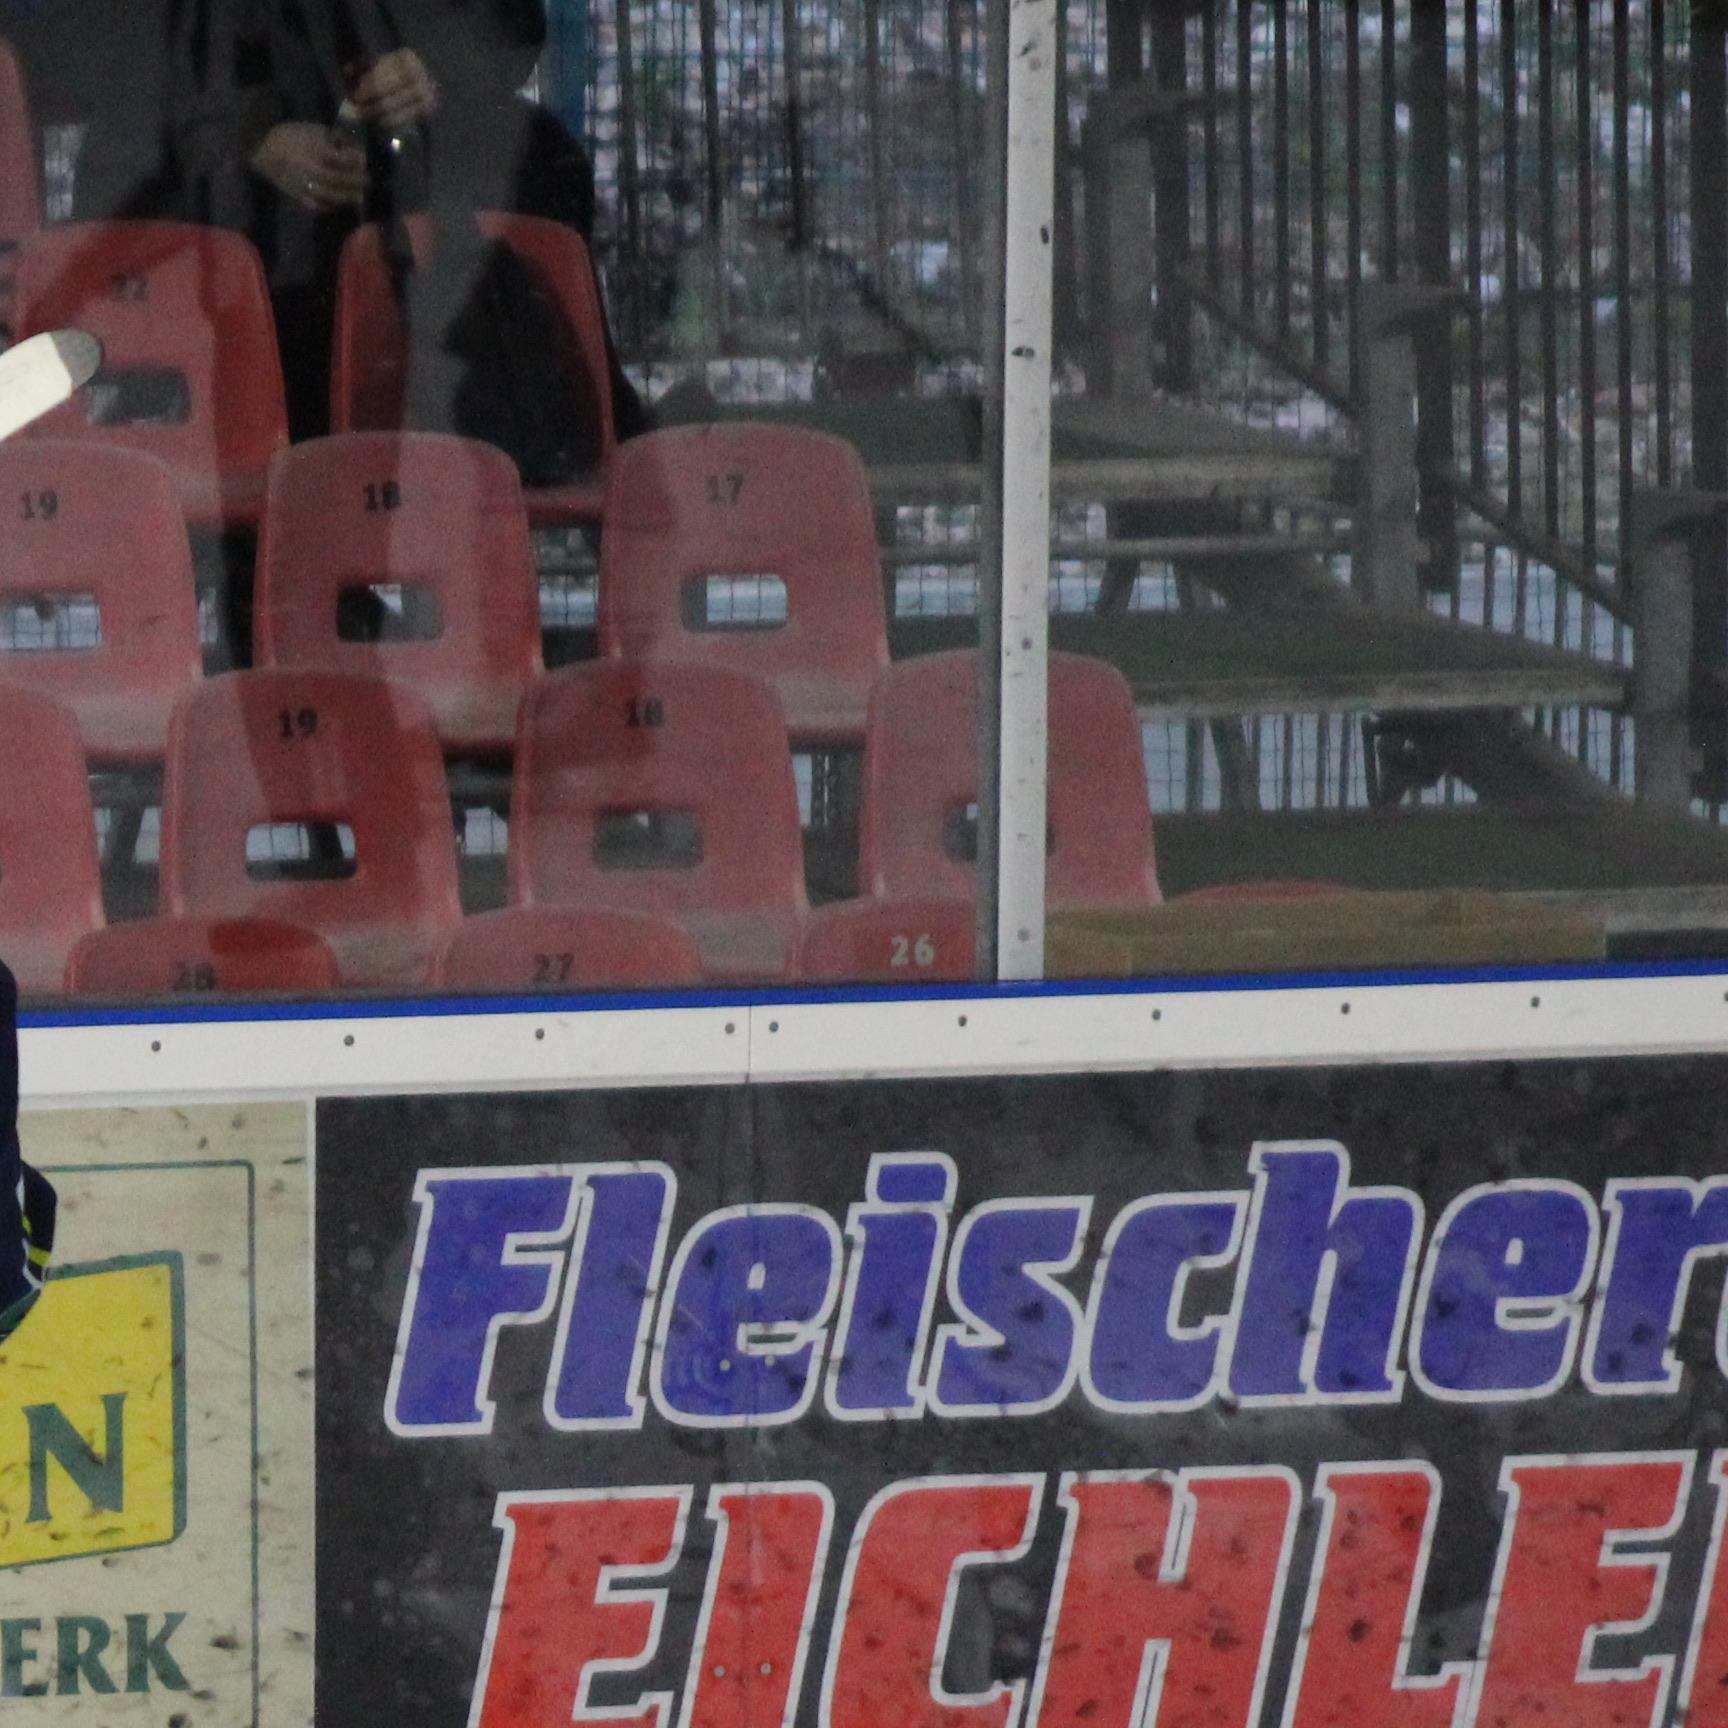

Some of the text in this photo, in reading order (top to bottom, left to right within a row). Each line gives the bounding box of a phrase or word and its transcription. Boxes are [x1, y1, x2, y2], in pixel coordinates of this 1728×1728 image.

[18, 491, 59, 521] 19
[889, 936, 936, 966] 26
[384, 1140, 1728, 1437] Fleischer
[21, 1391, 127, 1525] N
